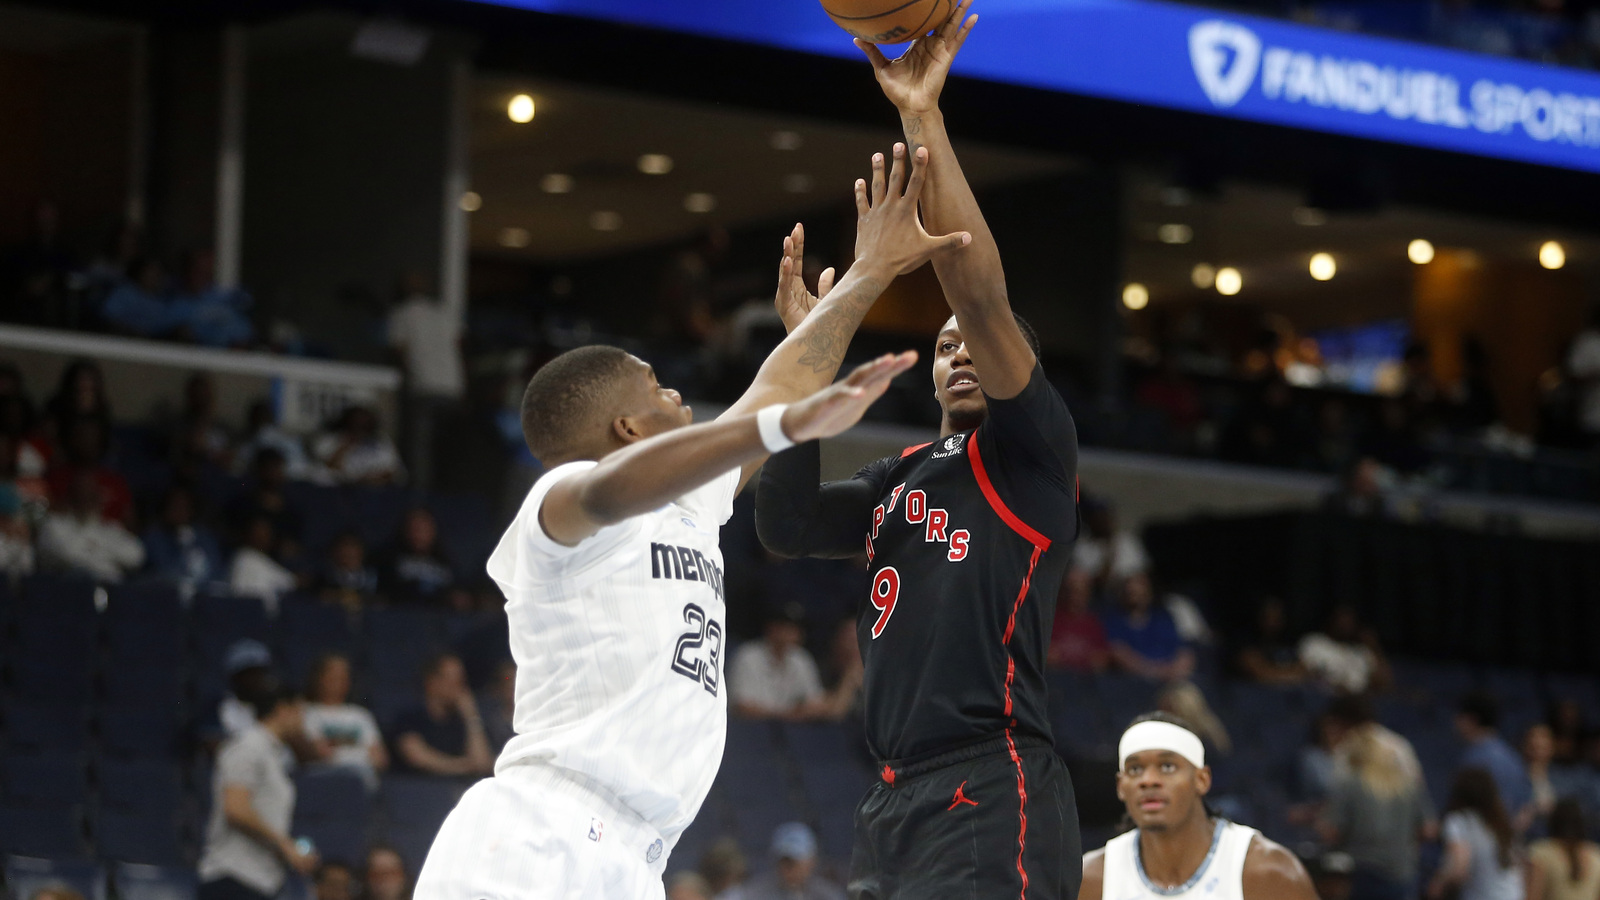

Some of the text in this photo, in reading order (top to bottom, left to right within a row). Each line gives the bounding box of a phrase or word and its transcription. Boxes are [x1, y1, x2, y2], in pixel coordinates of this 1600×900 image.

[1261, 47, 1469, 129] FANDUEL
[931, 451, 947, 459] Sun
[866, 482, 970, 571] APTORS
[871, 566, 900, 640] 9
[671, 603, 721, 697] 23
